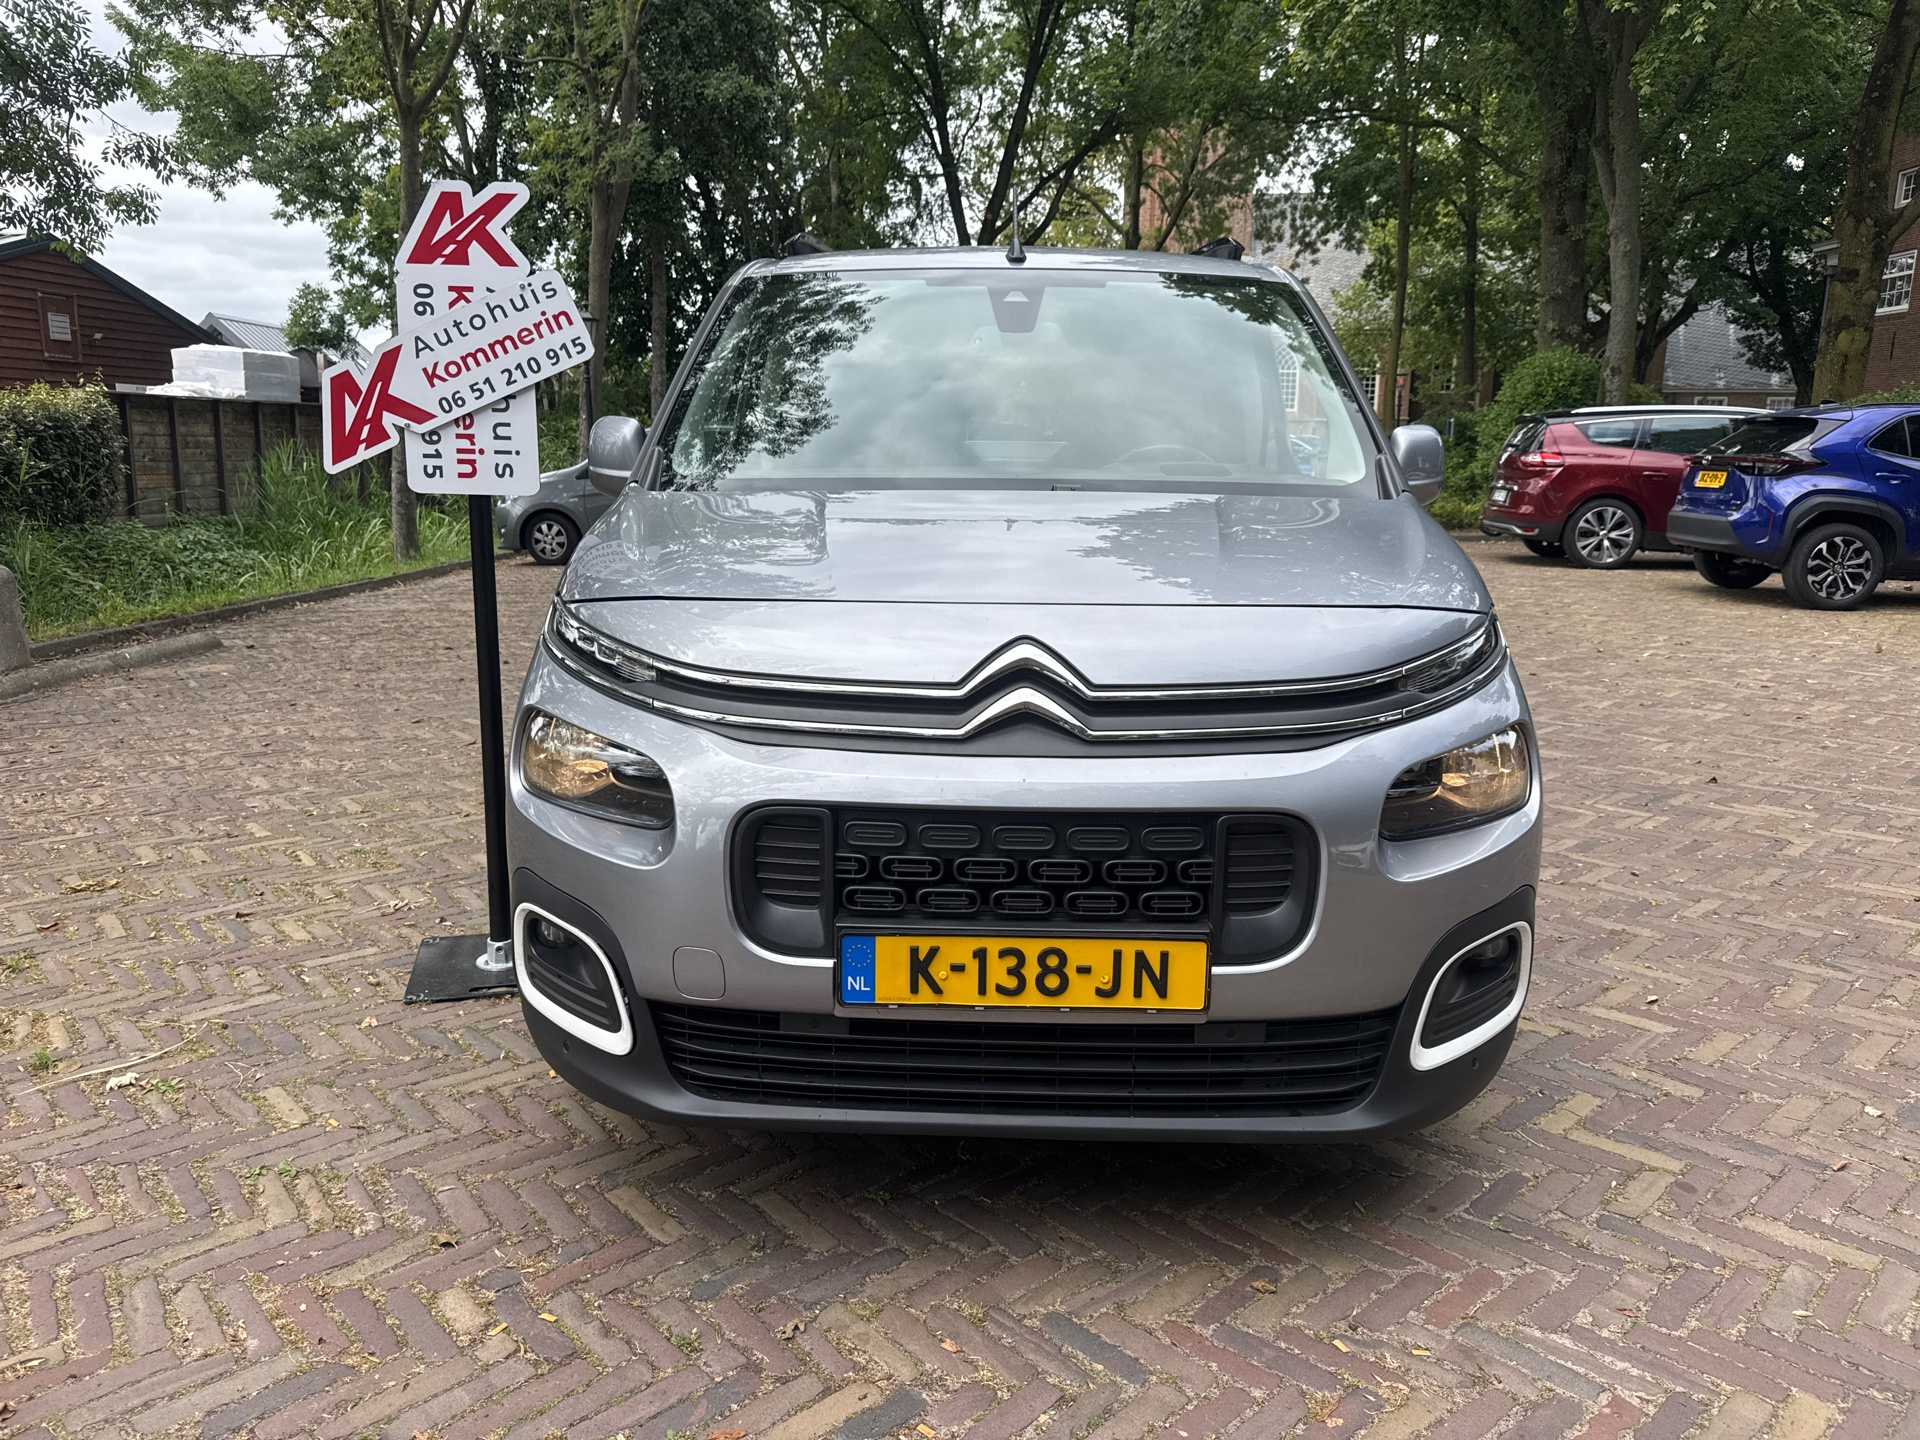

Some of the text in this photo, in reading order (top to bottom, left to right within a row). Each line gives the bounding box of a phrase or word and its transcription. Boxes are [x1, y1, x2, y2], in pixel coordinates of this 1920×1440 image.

[413, 281, 558, 359] Autohuis
[421, 309, 574, 389] Kommerin
[413, 282, 444, 480] 06 915
[438, 336, 587, 415] 06 51 210 915
[847, 945, 1170, 1000] NL K-138-JN
